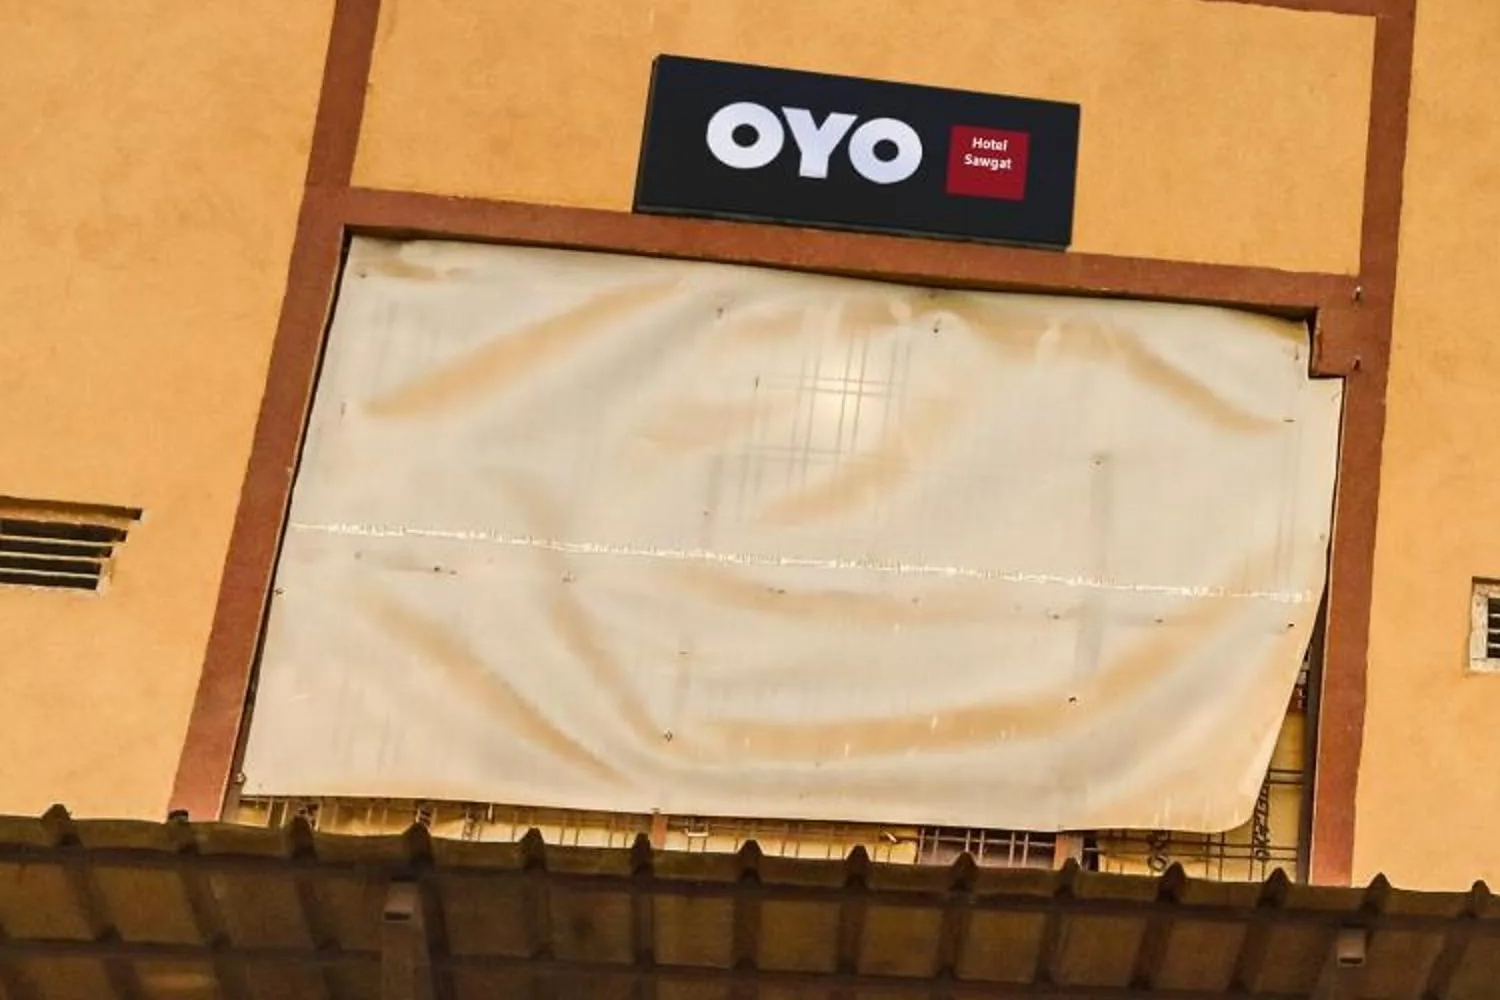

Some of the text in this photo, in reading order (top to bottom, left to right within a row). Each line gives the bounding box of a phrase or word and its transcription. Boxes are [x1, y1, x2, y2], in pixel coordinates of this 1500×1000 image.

[706, 101, 923, 184] OYO
[972, 136, 1009, 152] Hotel
[963, 153, 1012, 171] Sawgat
